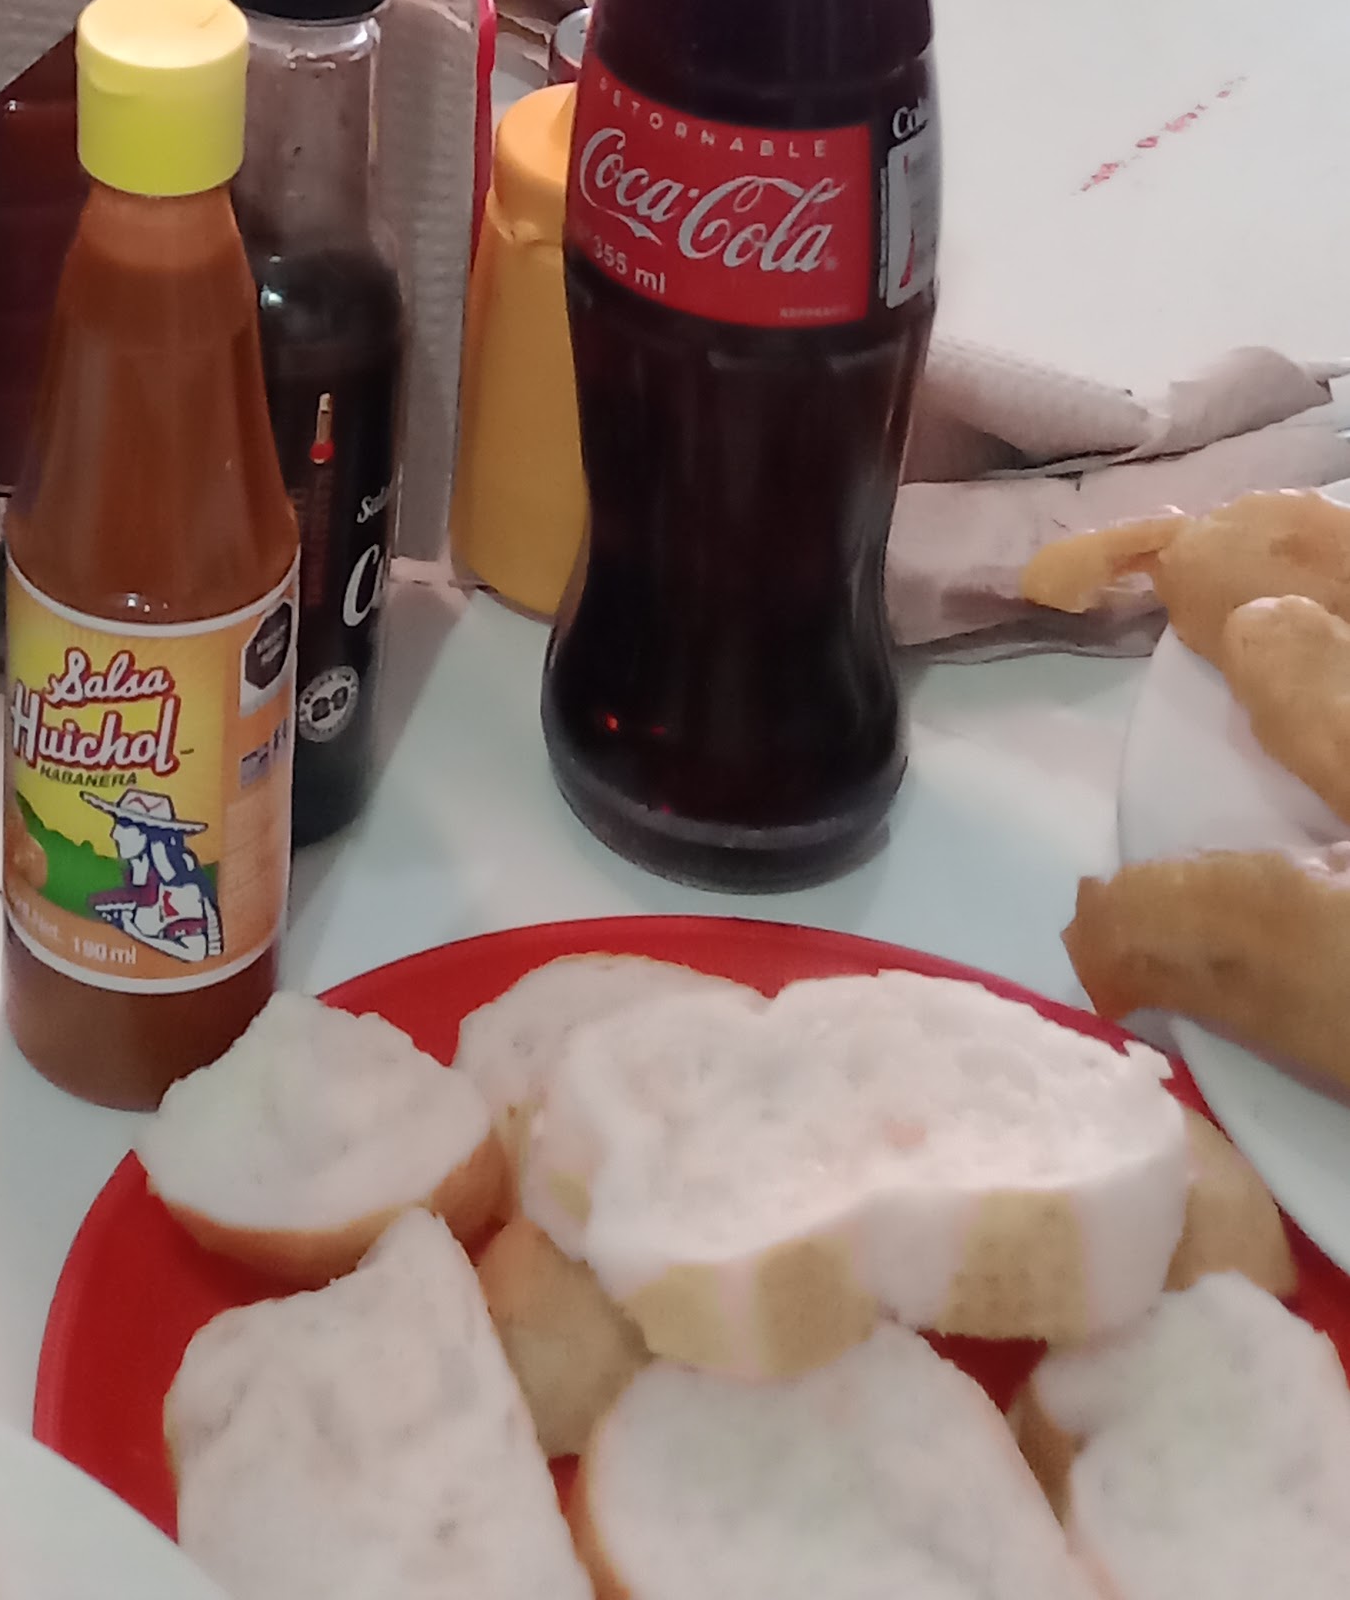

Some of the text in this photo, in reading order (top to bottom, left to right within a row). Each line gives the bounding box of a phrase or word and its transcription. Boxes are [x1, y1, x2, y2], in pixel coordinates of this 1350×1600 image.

[580, 127, 846, 273] Coca-Cola
[635, 267, 666, 294] ml
[49, 648, 174, 706] Salsa
[11, 680, 179, 776] Huichol
[40, 764, 138, 788] HABANERA
